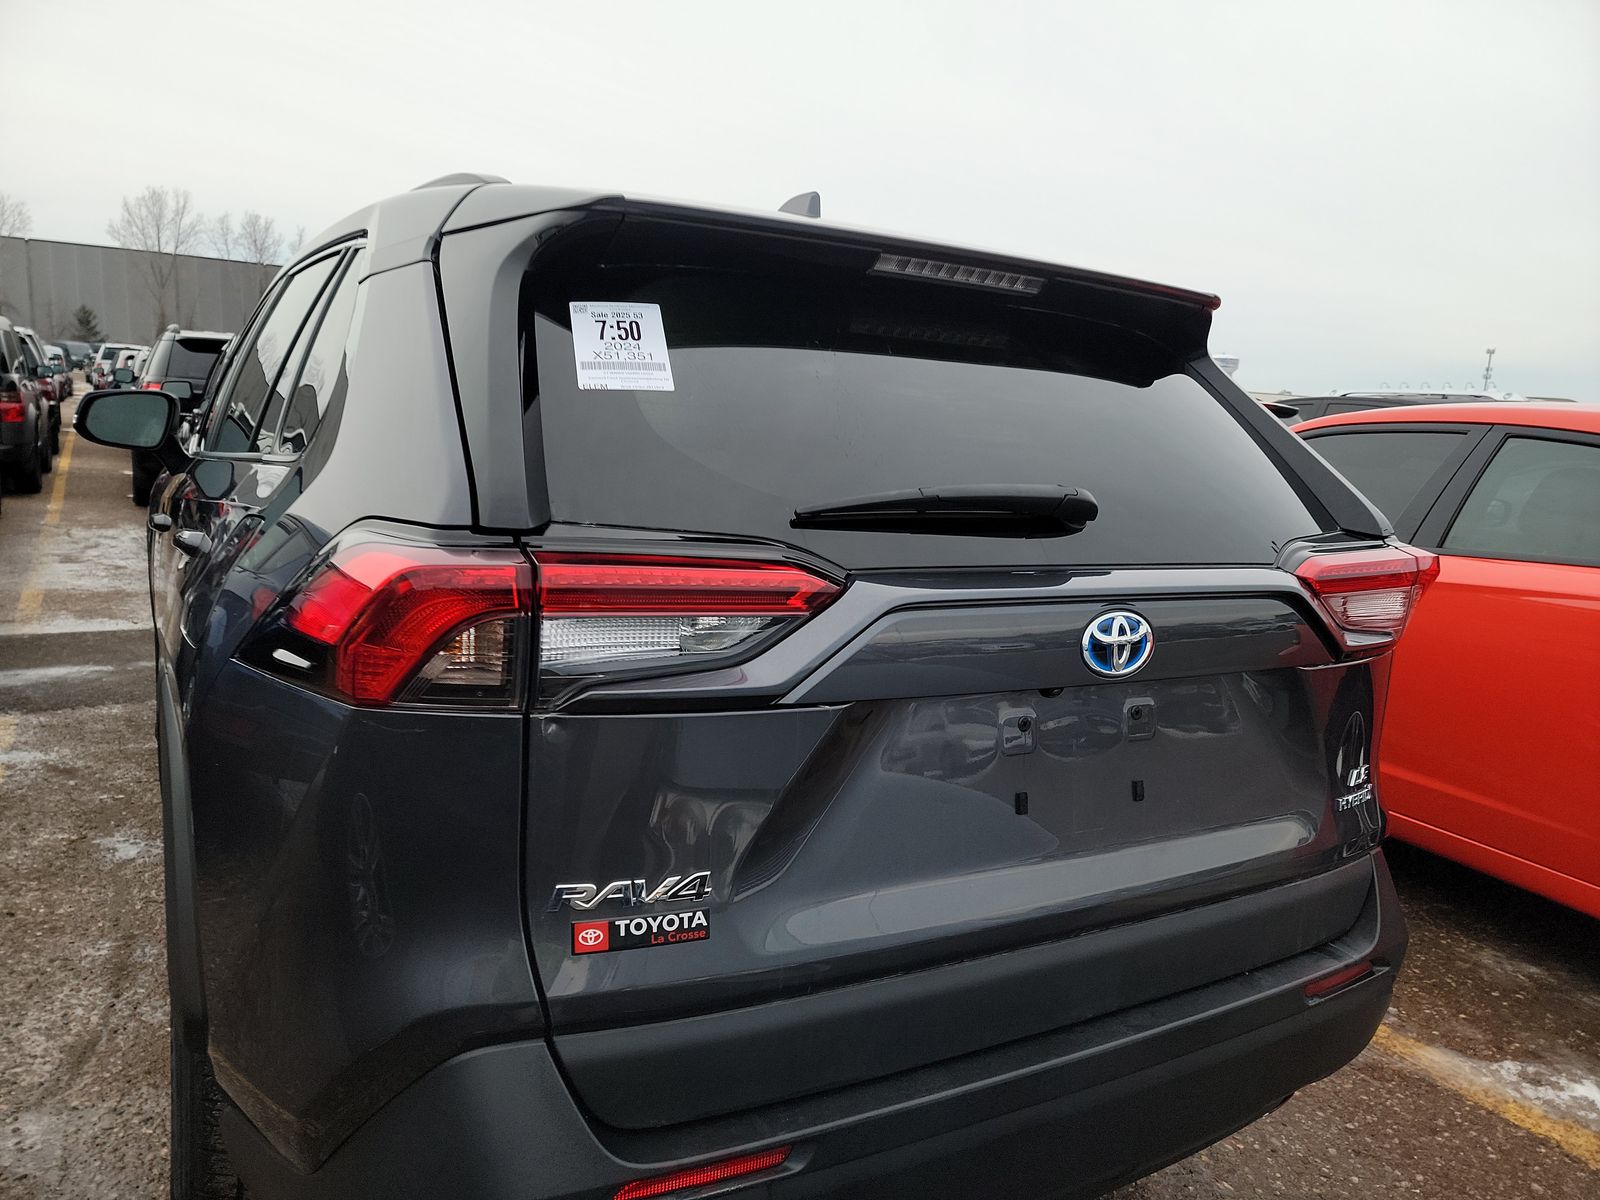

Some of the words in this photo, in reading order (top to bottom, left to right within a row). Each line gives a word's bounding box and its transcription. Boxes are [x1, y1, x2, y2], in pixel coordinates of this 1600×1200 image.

[590, 311, 609, 319] Sale
[611, 311, 631, 319] 2025
[594, 320, 642, 341] 7:50
[604, 342, 641, 351] 2024
[546, 871, 712, 913] RAV4
[614, 910, 708, 937] TOYOTA
[651, 933, 664, 945] La
[667, 929, 706, 943] Crosse
